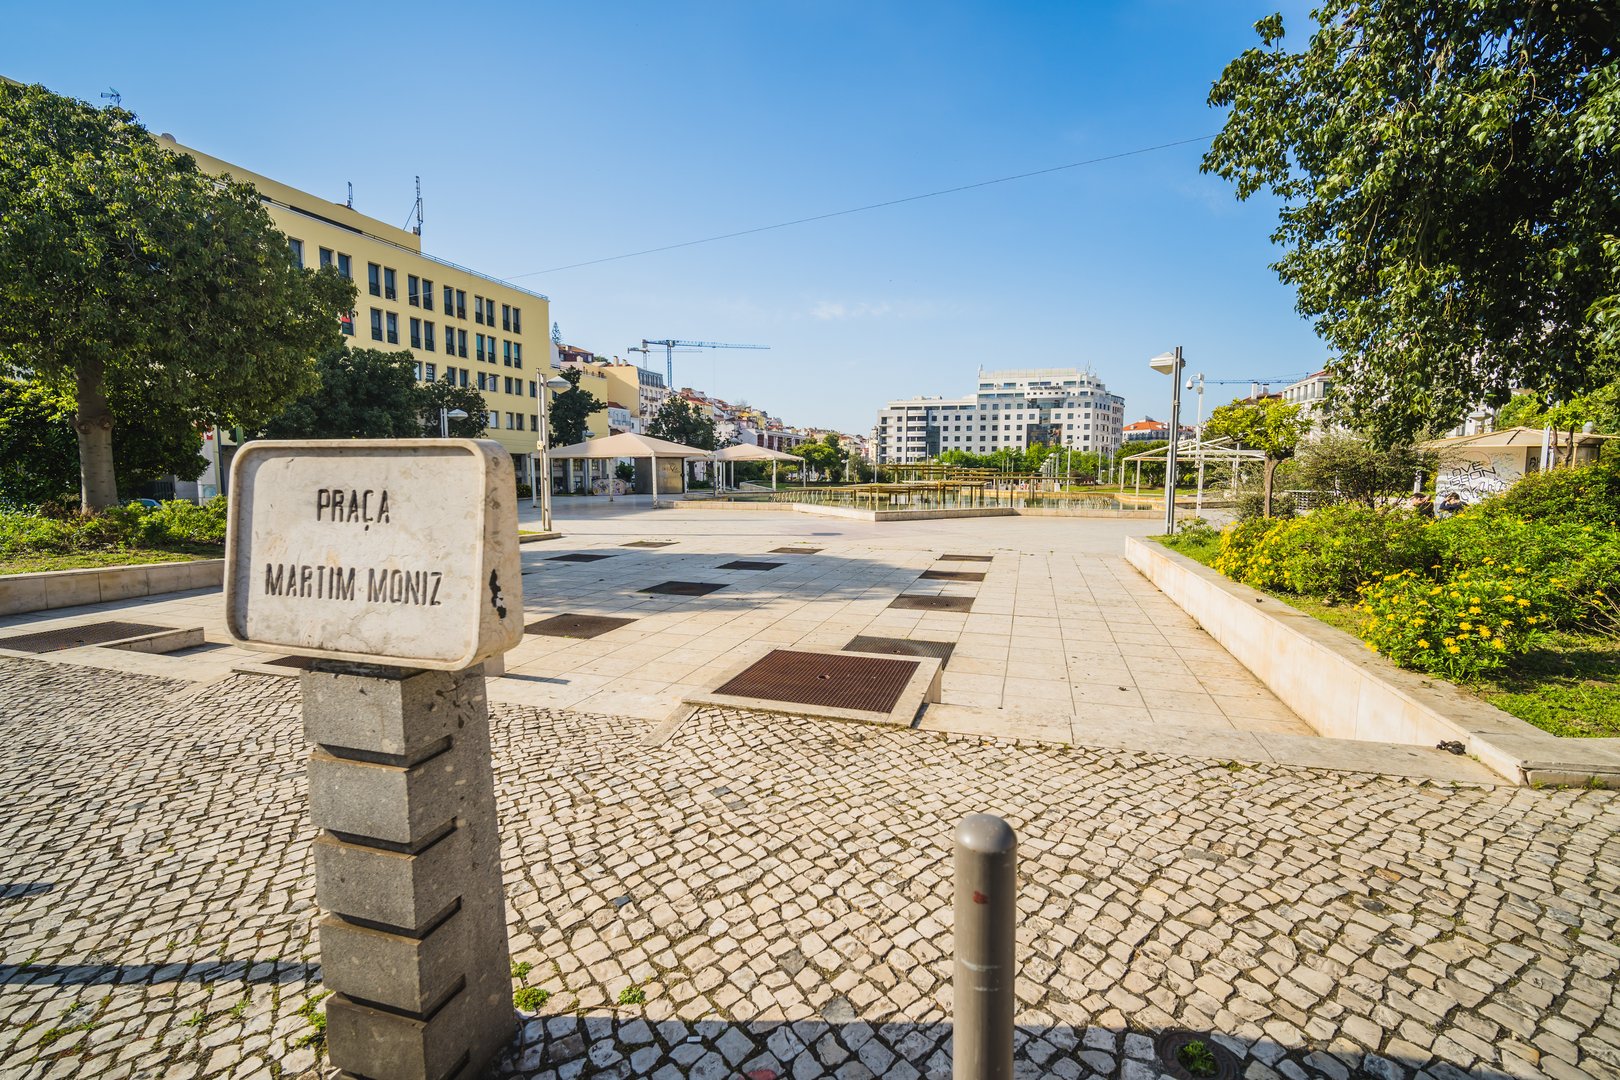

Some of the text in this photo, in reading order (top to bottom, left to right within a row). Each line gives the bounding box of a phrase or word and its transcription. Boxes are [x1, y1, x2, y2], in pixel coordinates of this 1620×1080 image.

[316, 488, 390, 531] PRAÇA
[265, 563, 443, 606] MARTIM MONIZ
